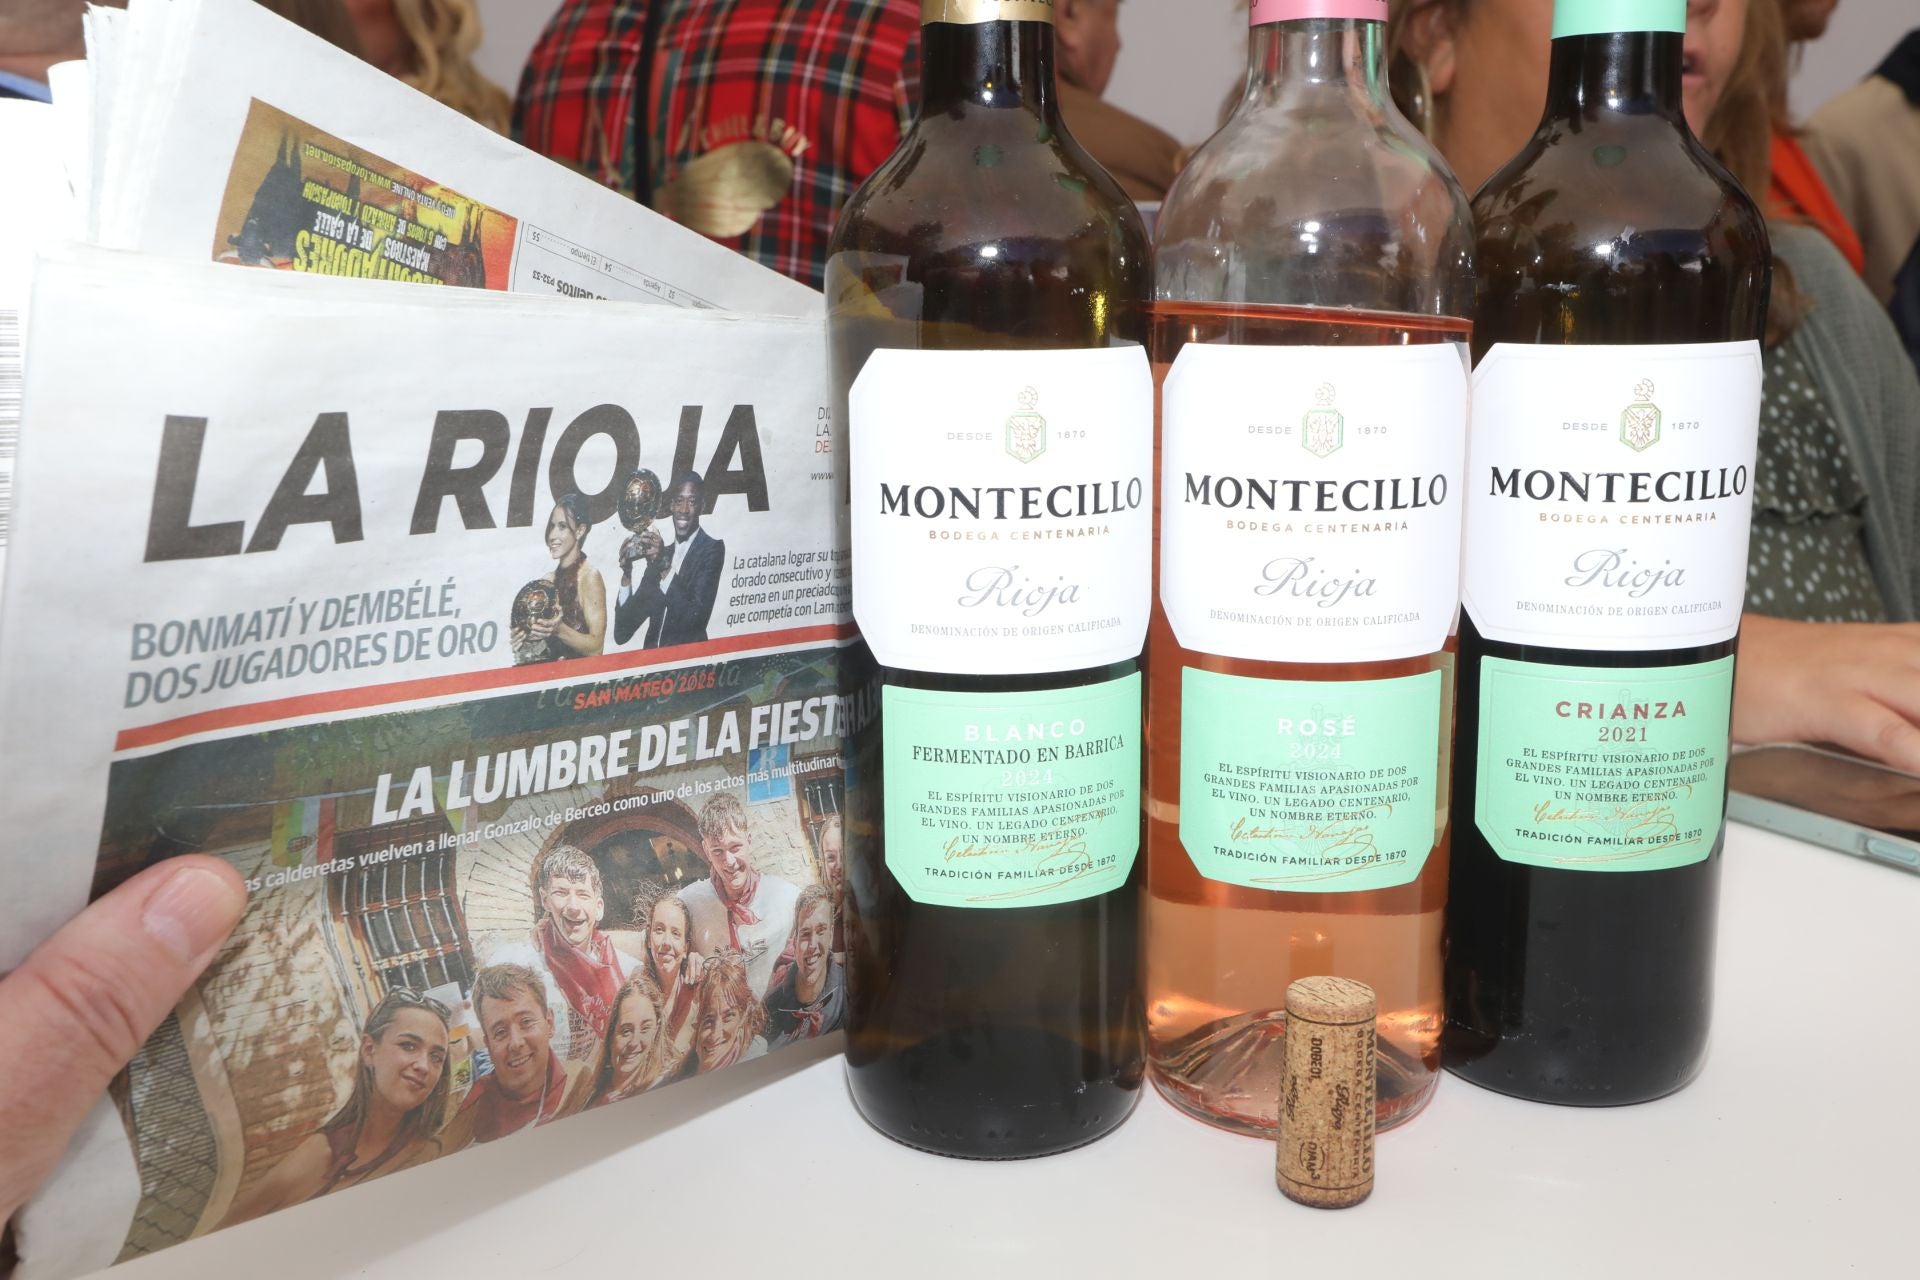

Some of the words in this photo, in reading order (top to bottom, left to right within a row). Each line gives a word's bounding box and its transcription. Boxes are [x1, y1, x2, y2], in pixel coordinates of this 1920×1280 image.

[532, 231, 540, 242] 55
[947, 432, 993, 441] DESDE
[1057, 430, 1086, 439] 1870
[1248, 425, 1292, 434] DESDE
[1358, 426, 1387, 435] 1870
[1562, 422, 1608, 431] DESDE
[1671, 422, 1700, 430] 1870
[144, 412, 364, 563] LA
[409, 402, 770, 536] RIOJA
[1184, 472, 1447, 512] MONTECILLO
[1490, 464, 1747, 503] MONTECILLO
[880, 477, 1142, 520] MONTECILLO
[1226, 520, 1293, 533] BODEGA
[1304, 521, 1408, 533] CENTENARIA
[1539, 513, 1608, 524] BODEGA
[1620, 512, 1716, 525] CENTENARIA
[929, 530, 999, 541] BODEGA
[1010, 526, 1110, 540] CENTENARIA
[733, 556, 745, 570] La
[747, 552, 787, 569] catalana
[788, 550, 816, 567] lograr
[817, 551, 829, 562] su
[731, 571, 766, 588] dorado
[768, 567, 824, 585] consecutivo
[825, 568, 832, 582] y
[1253, 557, 1377, 608] Rioja
[1564, 548, 1686, 598] Rioja
[729, 591, 766, 607] estrena
[768, 590, 780, 603] en
[782, 588, 794, 601] un
[957, 565, 1080, 617] Rioja
[130, 597, 296, 661] BONMATÍ
[298, 600, 318, 635] Y
[319, 576, 462, 631] DEMBÉLÉ,
[726, 613, 746, 627] que
[747, 604, 792, 623] competía
[794, 604, 811, 617] con
[1210, 609, 1292, 626] DENOMINACIÓN
[1296, 617, 1312, 627] DE
[1316, 616, 1359, 627] ORIGEN
[1363, 612, 1420, 625] CALIFICADA
[1516, 600, 1602, 616] DENOMINACIÓN
[1608, 607, 1623, 616] DE
[1627, 606, 1667, 617] ORIGEN
[1671, 600, 1721, 615] CALIFICADA
[911, 623, 998, 637] DENOMINACIÓN
[1003, 627, 1018, 637] DE
[1022, 624, 1064, 636] ORIGEN
[1068, 617, 1121, 634] CALIFICADA
[124, 663, 201, 709] DOS
[201, 632, 388, 694] JUGADORES
[393, 627, 432, 663] DE
[438, 620, 499, 656] ORO
[574, 691, 613, 710] SAN
[615, 678, 674, 702] MATEO
[678, 671, 716, 693] 2025
[1555, 701, 1686, 720] CRIANZA
[964, 719, 1085, 742] BLANCO
[1278, 715, 1356, 736] ROSÉ
[1599, 727, 1648, 742] 2021
[912, 745, 1031, 764] FERMENTADO
[1038, 746, 1059, 763] EN
[1065, 734, 1124, 760] BARRICA
[1290, 743, 1342, 759] 2024
[1523, 747, 1538, 758] EL
[1541, 750, 1597, 763] ESPÍRITU
[1602, 752, 1669, 764] VISIONARIO
[1672, 751, 1686, 761] DE
[1688, 747, 1706, 759] DOS
[371, 766, 435, 826] LA
[446, 728, 632, 811] LUMBRE
[638, 719, 689, 772] DE
[696, 711, 741, 760] LA
[749, 695, 839, 750] FIEST
[1506, 759, 1561, 774] GRANDES
[1565, 766, 1622, 776] FAMILIAS
[1626, 762, 1698, 777] APASIONADAS
[1700, 757, 1715, 769] POR
[1001, 768, 1053, 787] 2024
[1219, 762, 1234, 773] EL
[1236, 765, 1291, 779] ESPÍRITU
[1295, 770, 1365, 781] VISIONARIO
[1370, 769, 1385, 779] DE
[1387, 765, 1407, 776] DOS
[1515, 772, 1530, 782] EL
[1533, 775, 1565, 787] VINO.
[1570, 778, 1587, 788] UN
[1593, 780, 1640, 789] LEGADO
[928, 790, 942, 801] EL
[946, 791, 1003, 803] ESPÍRITU
[1007, 788, 1077, 802] VISIONARIO
[1080, 785, 1093, 796] DE
[1096, 779, 1114, 793] DOS
[1204, 773, 1256, 790] GRANDES
[1260, 782, 1316, 795] FAMILIAS
[1320, 782, 1398, 795] APASIONADAS
[1401, 777, 1419, 788] POR
[911, 803, 967, 816] GRANDES
[971, 807, 1029, 817] FAMILIAS
[1033, 796, 1107, 815] APASIONADAS
[1109, 790, 1125, 802] POR
[1211, 788, 1226, 799] EL
[1229, 791, 1260, 804] VINO.
[1264, 796, 1281, 806] UN
[1285, 797, 1335, 808] LEGADO
[1555, 791, 1572, 800] UN
[1575, 792, 1627, 803] NOMBRE
[1632, 791, 1679, 802] ETERNO.
[1249, 807, 1266, 818] UN
[1270, 810, 1322, 821] NOMBRE
[1327, 810, 1377, 821] ETERNO.
[266, 856, 355, 888] calderetas
[358, 841, 422, 868] vuelven
[426, 841, 435, 853] a
[438, 828, 481, 850] llenar
[484, 816, 540, 840] Gonzalo
[545, 811, 562, 827] de
[565, 802, 611, 822] Berceo
[613, 794, 648, 811] como
[651, 789, 674, 805] uno
[677, 782, 692, 797] de
[695, 778, 711, 794] los
[714, 773, 744, 790] actos
[747, 765, 768, 785] más
[921, 818, 935, 828] EL
[939, 819, 972, 831] VINO.
[977, 821, 994, 830] UN
[999, 819, 1047, 830] LEGADO
[962, 834, 979, 844] UN
[984, 833, 1036, 844] NOMBRE
[1040, 827, 1087, 842] ETERNO.
[1516, 828, 1582, 844] TRADICIÓN
[1587, 836, 1643, 845] FAMILIAR
[1648, 832, 1681, 844] DESDE
[1684, 828, 1702, 840] 1870
[1213, 846, 1277, 864] TRADICIÓN
[1282, 856, 1340, 866] FAMILIAR
[1346, 853, 1381, 865] DESDE
[1385, 849, 1407, 861] 1870
[925, 867, 992, 879] TRADICIÓN
[997, 868, 1054, 880] FAMILIAR
[1060, 861, 1093, 875] DESDE
[1096, 854, 1116, 866] 1870
[1361, 1028, 1375, 1174] MONTECILLO
